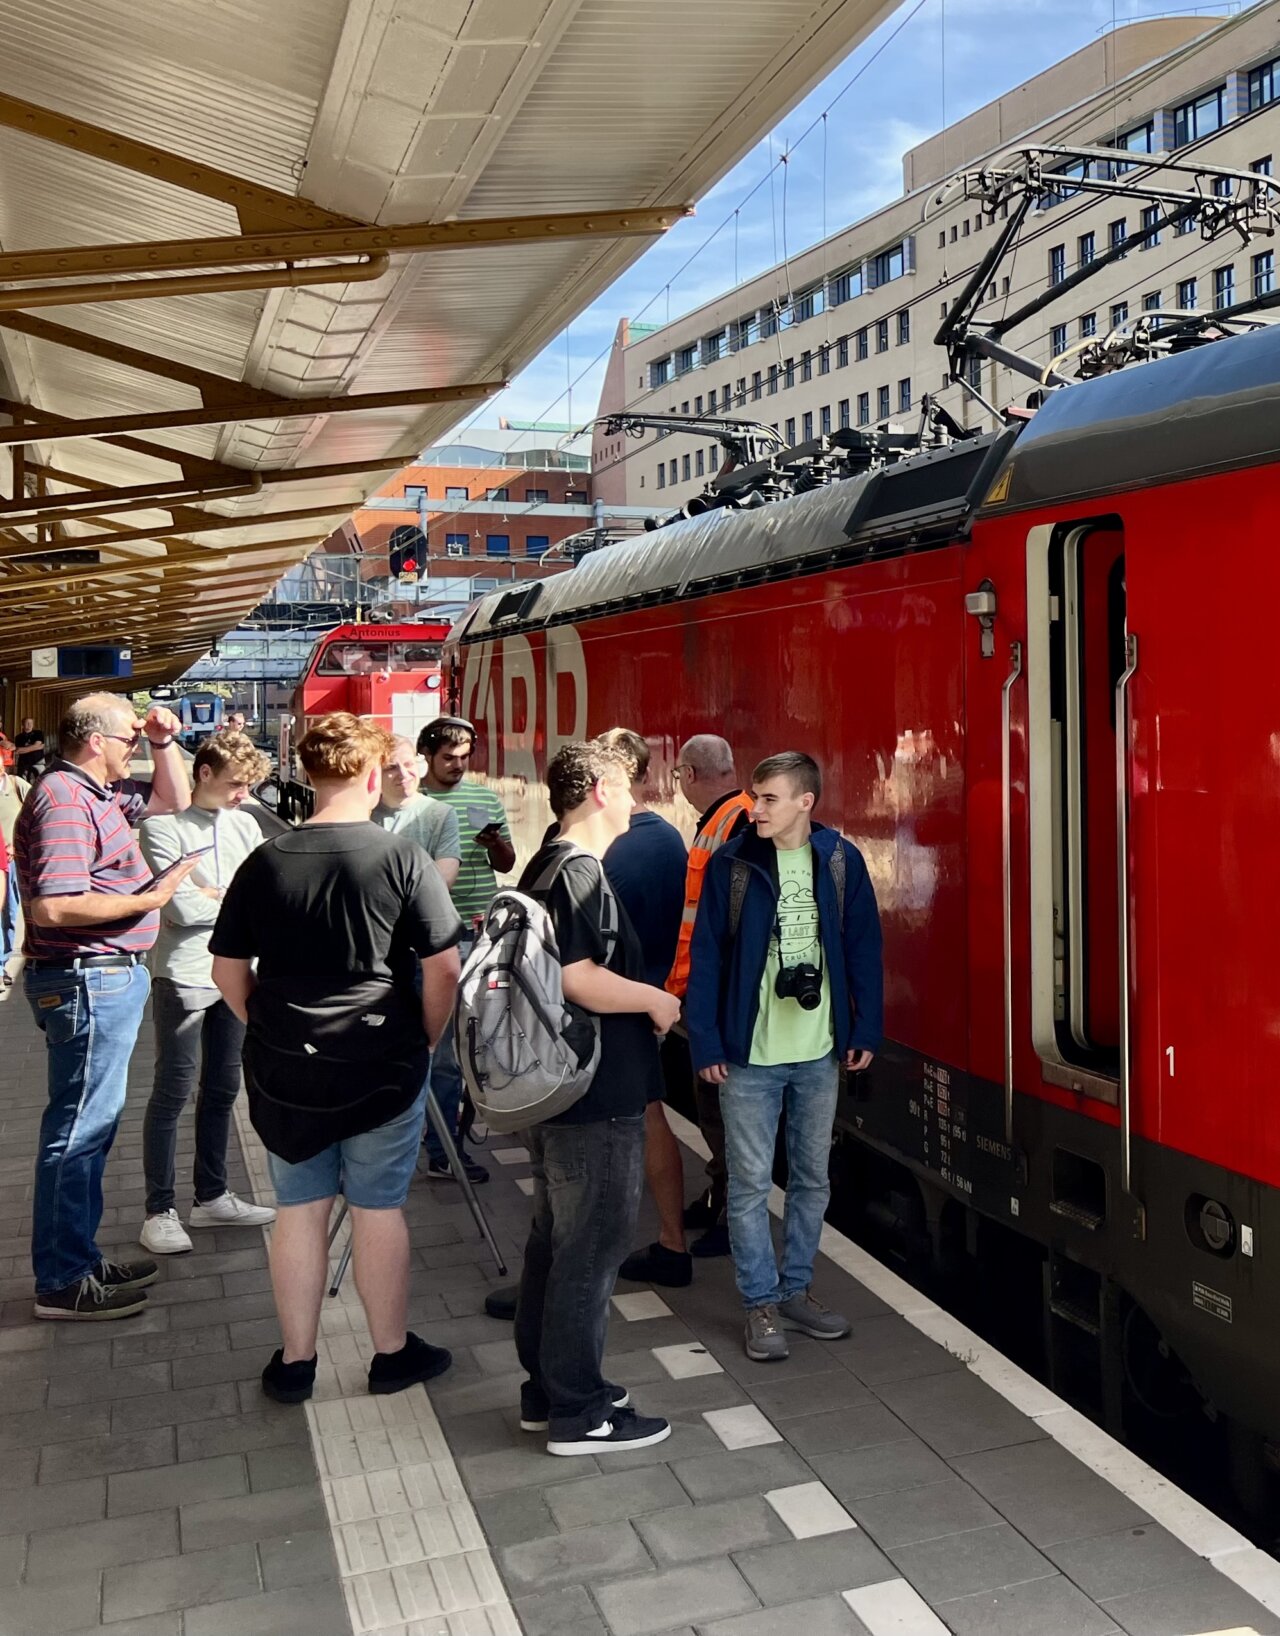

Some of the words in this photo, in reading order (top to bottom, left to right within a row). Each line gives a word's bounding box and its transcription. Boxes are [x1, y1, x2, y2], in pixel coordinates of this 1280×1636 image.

[350, 628, 400, 637] Antonius
[785, 952, 807, 962] CRUZ
[1165, 1045, 1175, 1077] 1
[976, 1135, 1012, 1160] SIEMENS
